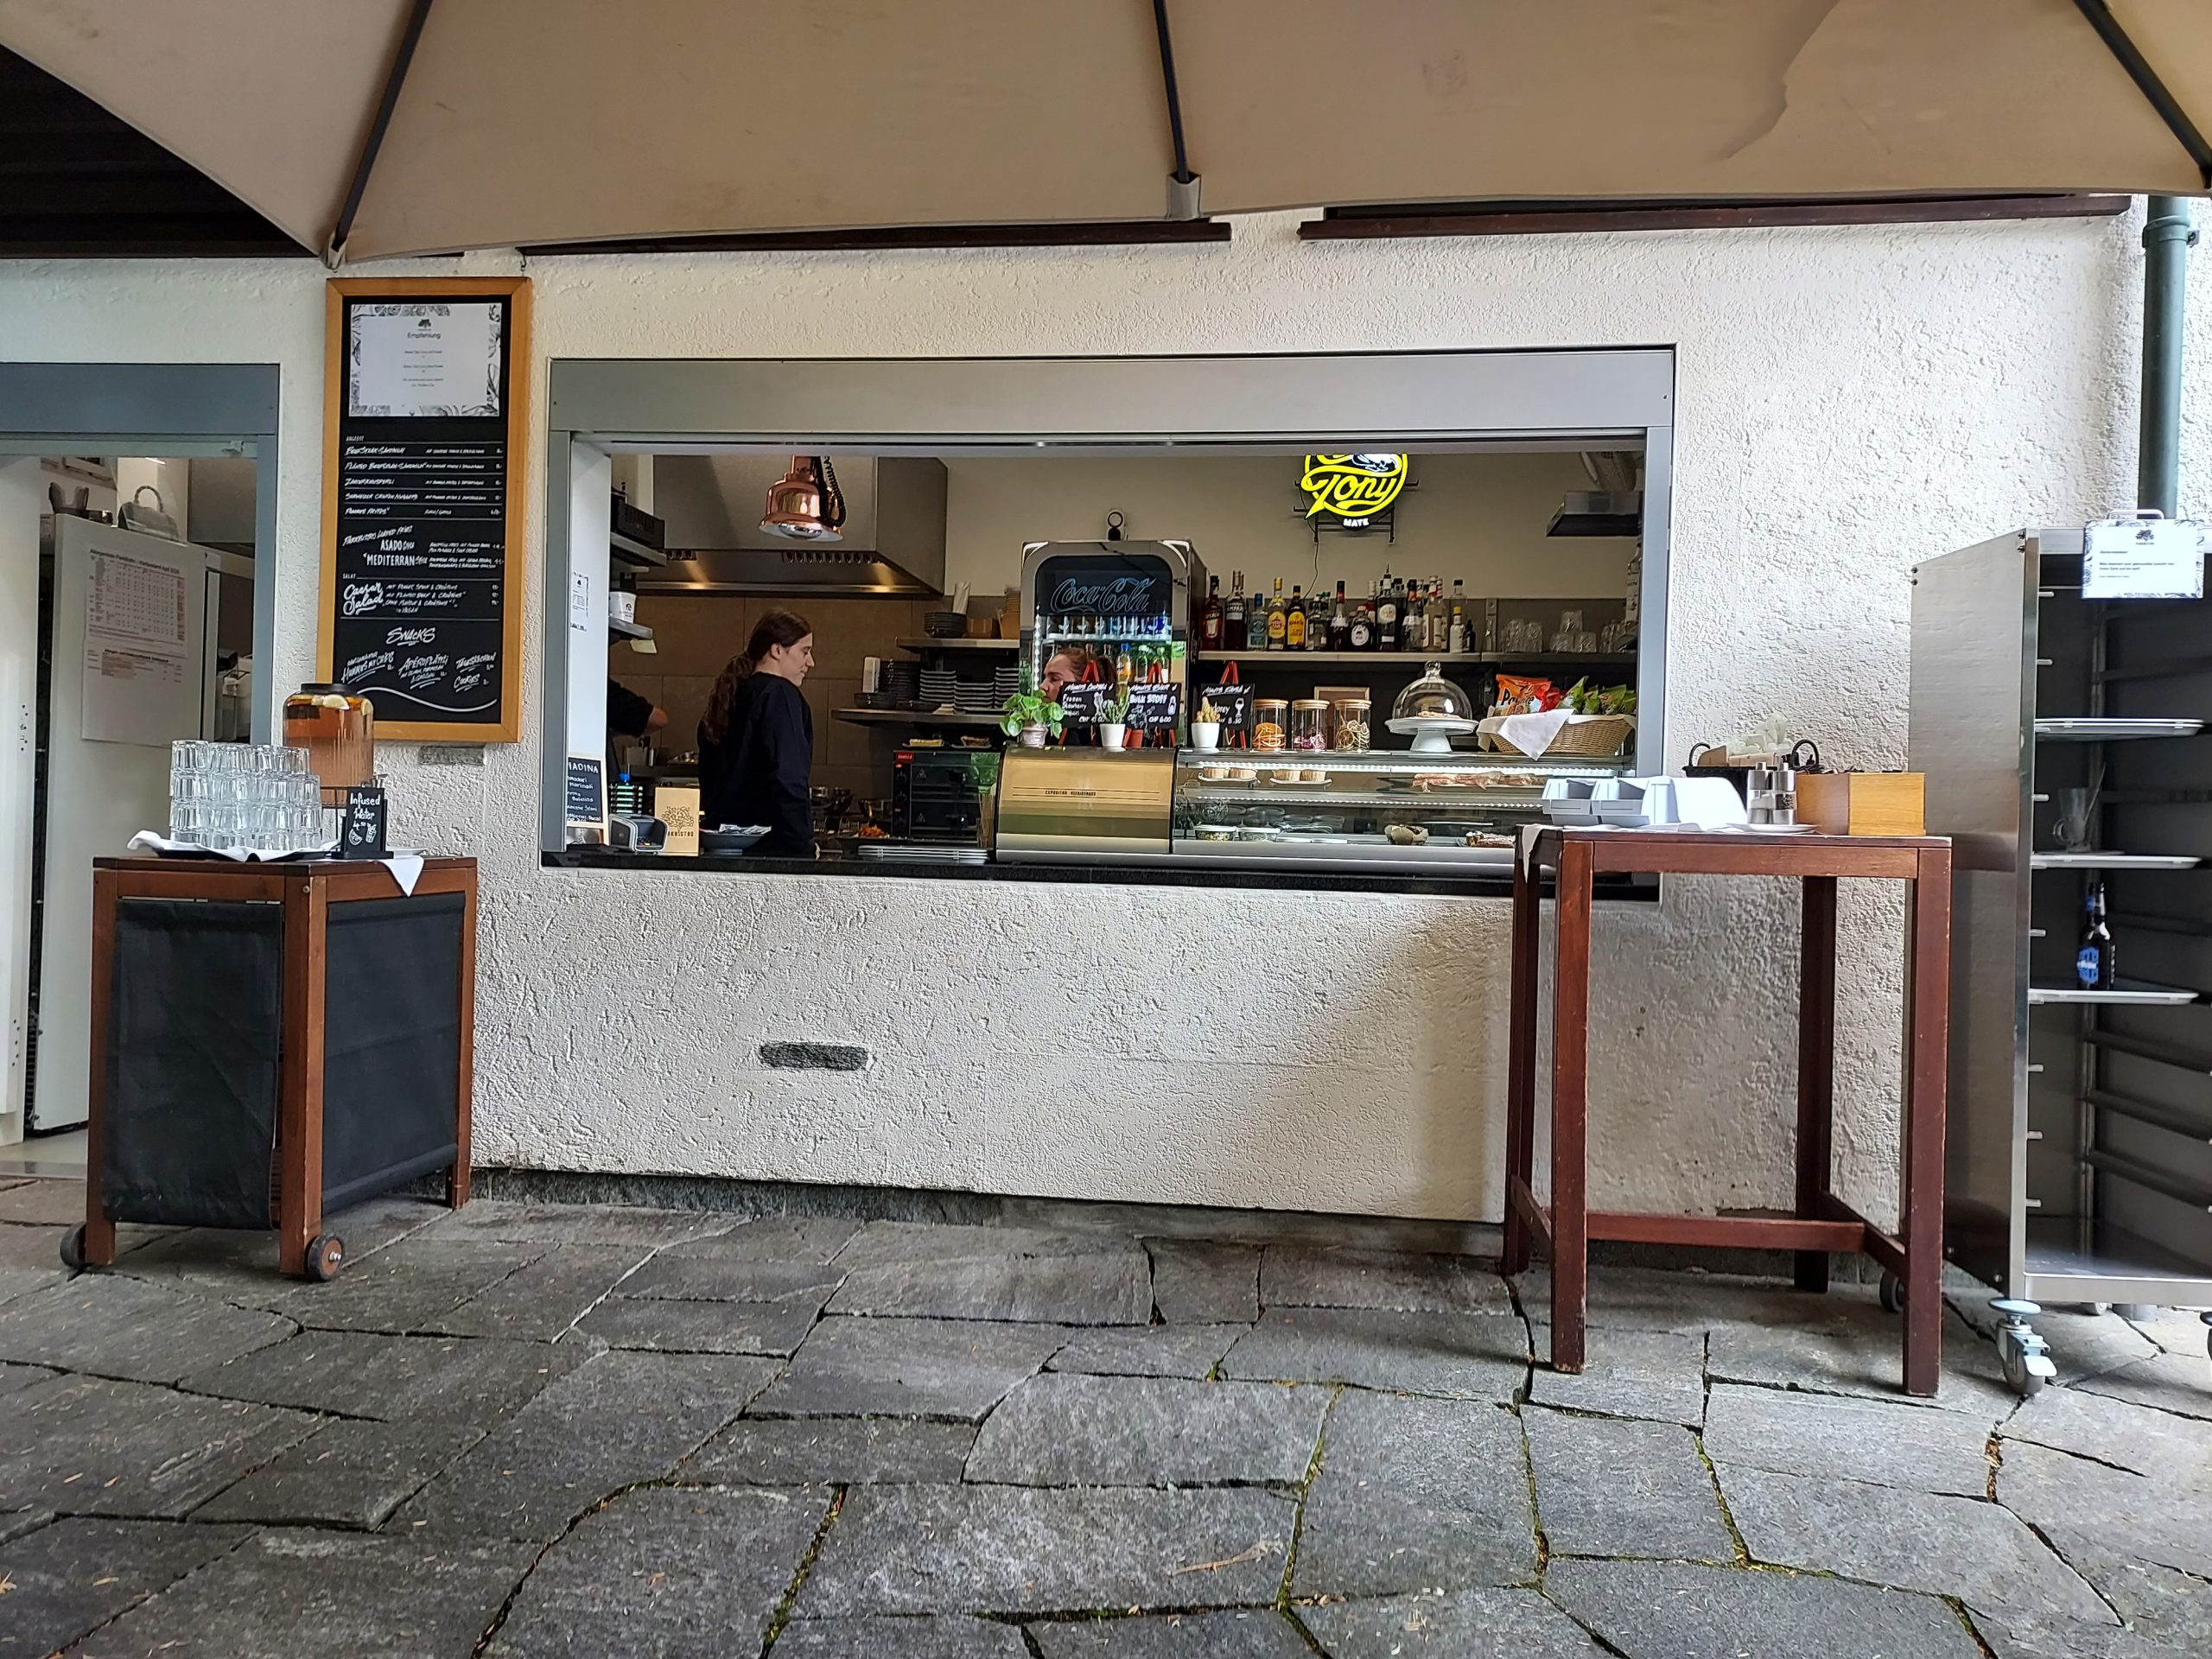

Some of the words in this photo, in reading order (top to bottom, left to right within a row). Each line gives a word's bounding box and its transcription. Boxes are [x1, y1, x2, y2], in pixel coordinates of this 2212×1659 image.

[1300, 467, 1397, 519] Tony
[397, 524, 414, 536] FRIES
[1343, 518, 1370, 527] MATE
[380, 539, 403, 551] ASADO
[366, 554, 416, 566] MEDITERRAN
[344, 582, 384, 600] Caesar
[1051, 576, 1157, 613] Coca-Cola
[343, 589, 384, 615] Salad
[385, 626, 436, 645] SNACKS
[453, 673, 480, 689] COOKIES
[568, 761, 599, 774] IADINA
[350, 792, 380, 809] Infused
[353, 807, 375, 820] Water
